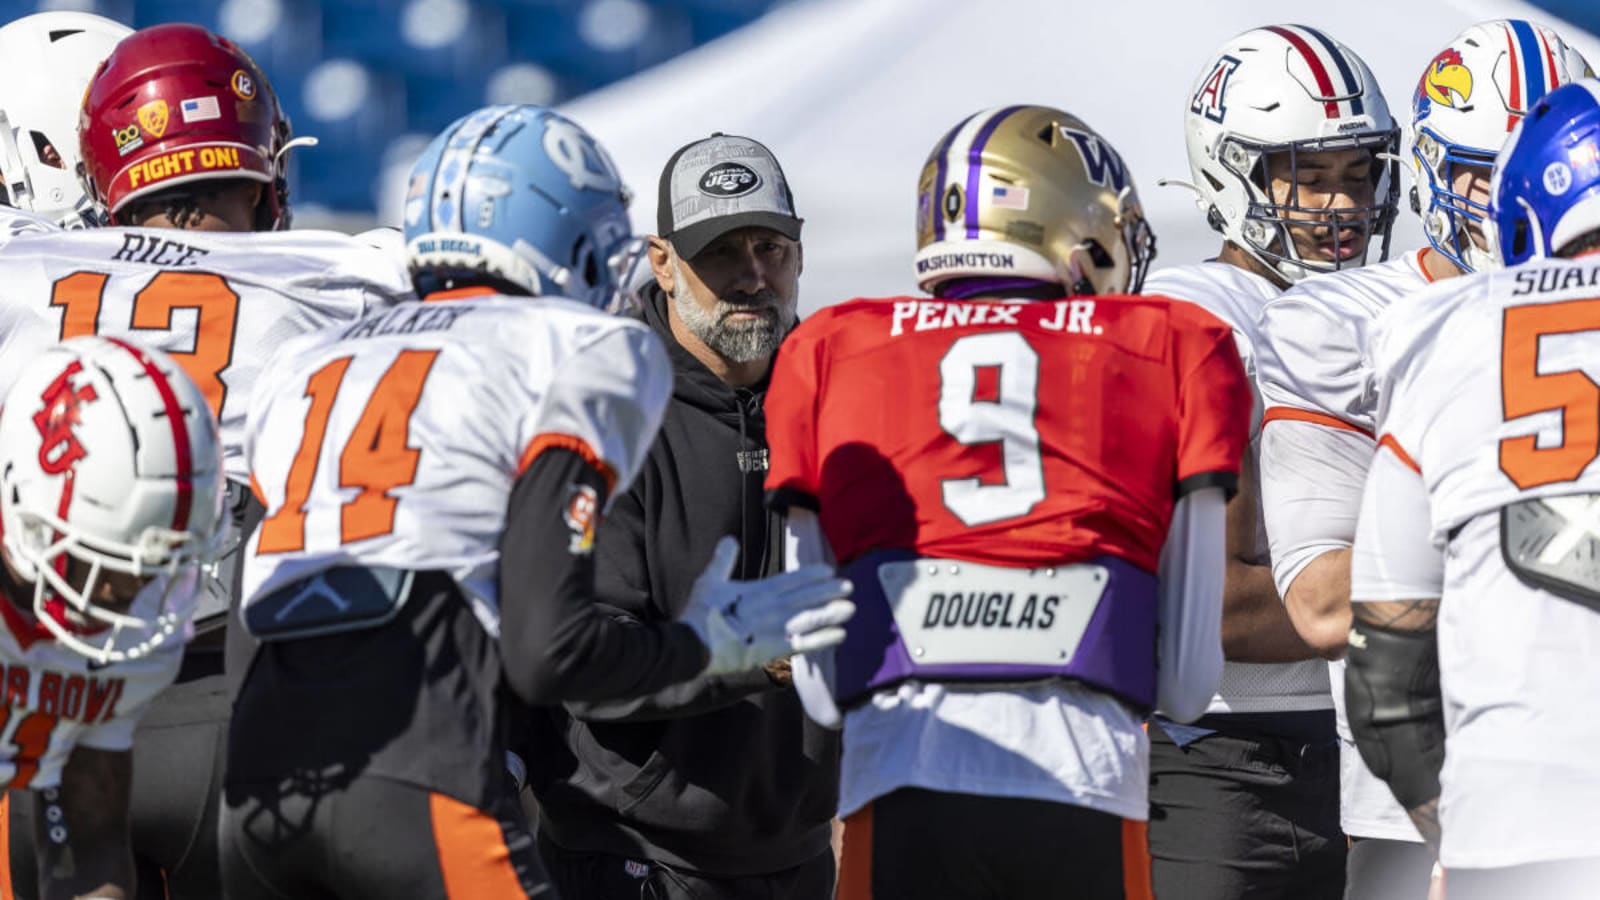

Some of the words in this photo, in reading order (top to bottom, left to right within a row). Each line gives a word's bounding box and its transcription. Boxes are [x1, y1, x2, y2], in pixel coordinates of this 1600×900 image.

[1191, 54, 1243, 124] A
[128, 150, 195, 188] FIGHT
[200, 147, 240, 168] ON!
[705, 172, 752, 187] JETS
[1060, 128, 1127, 193] W
[112, 233, 210, 267] RICE
[916, 252, 1014, 273] WASHINGTON
[890, 302, 1022, 336] PENIX
[1038, 300, 1104, 335] JR.
[1498, 297, 1600, 491] 5
[256, 349, 442, 556] 14
[938, 330, 1047, 527] 9
[922, 592, 1060, 629] DOUGLAS
[0, 663, 29, 709] R
[38, 669, 126, 724] BOWL
[0, 703, 58, 790] 1
